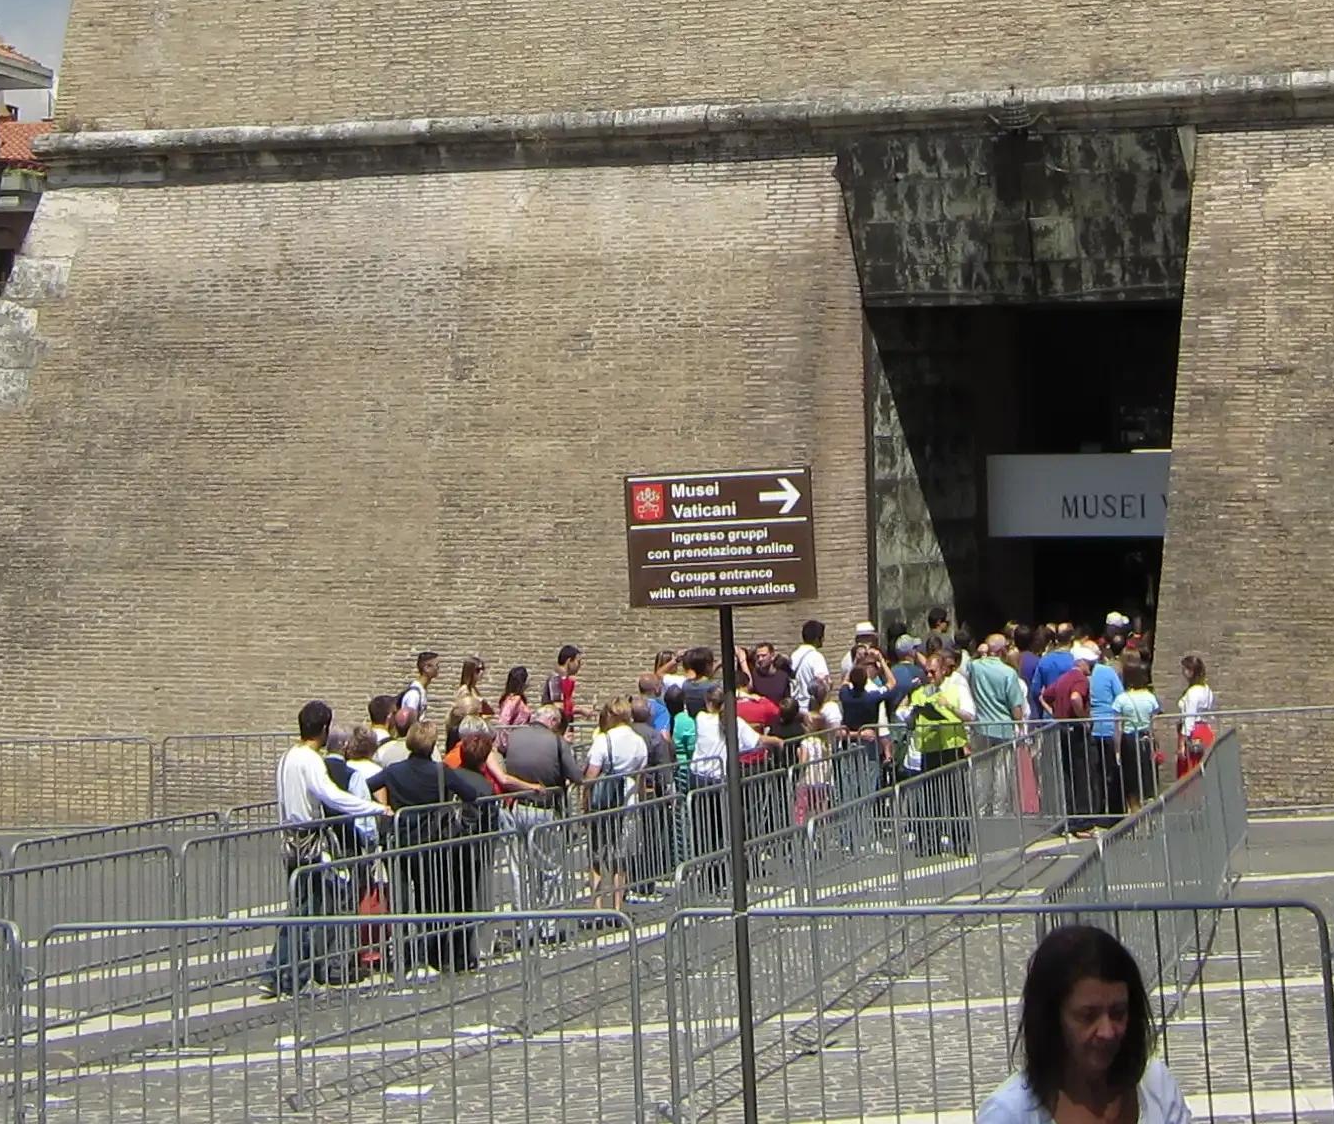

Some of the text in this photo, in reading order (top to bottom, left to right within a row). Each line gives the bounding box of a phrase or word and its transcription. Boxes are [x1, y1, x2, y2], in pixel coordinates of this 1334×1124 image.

[671, 482, 719, 498] Musei
[671, 501, 737, 519] Vaticani
[1061, 494, 1146, 519] MUSEI
[671, 527, 768, 544] Ingresso gruppi
[647, 542, 794, 560] con prenotazione online
[670, 568, 773, 584] Groups entrance
[649, 582, 796, 600] with online reservations
